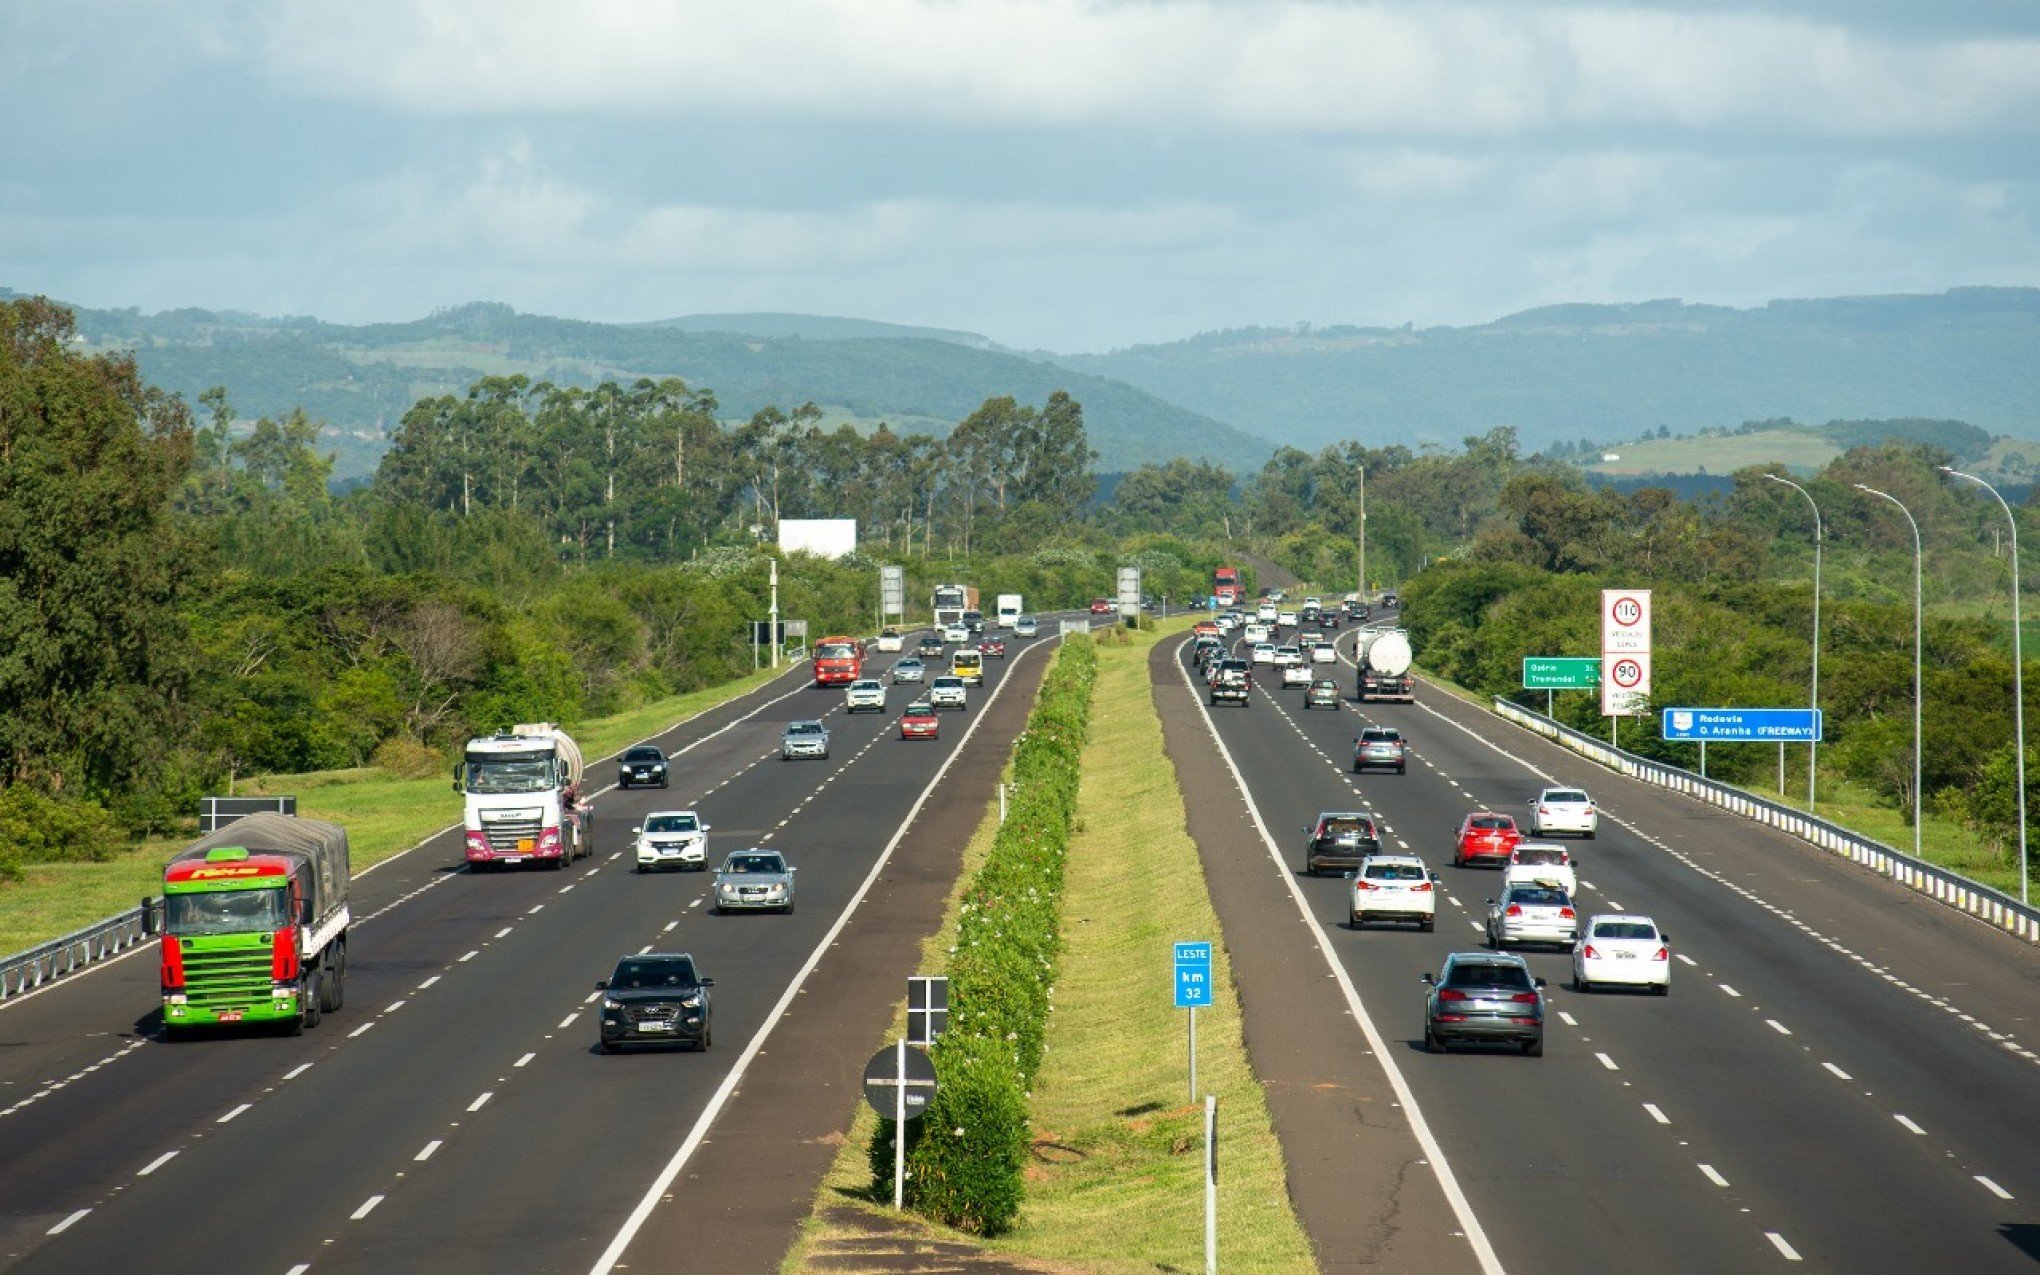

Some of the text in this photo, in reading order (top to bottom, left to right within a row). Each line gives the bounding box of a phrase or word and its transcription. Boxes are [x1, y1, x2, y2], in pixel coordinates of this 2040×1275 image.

[1618, 604, 1637, 616] 110
[1618, 665, 1636, 678] 90
[1700, 714, 1743, 723] Rodovia
[1712, 726, 1751, 736] Aranha
[1757, 726, 1814, 736] (FREEWAY)
[1177, 949, 1207, 959] LESTE
[1182, 971, 1204, 983] km
[1185, 987, 1201, 999] 32
